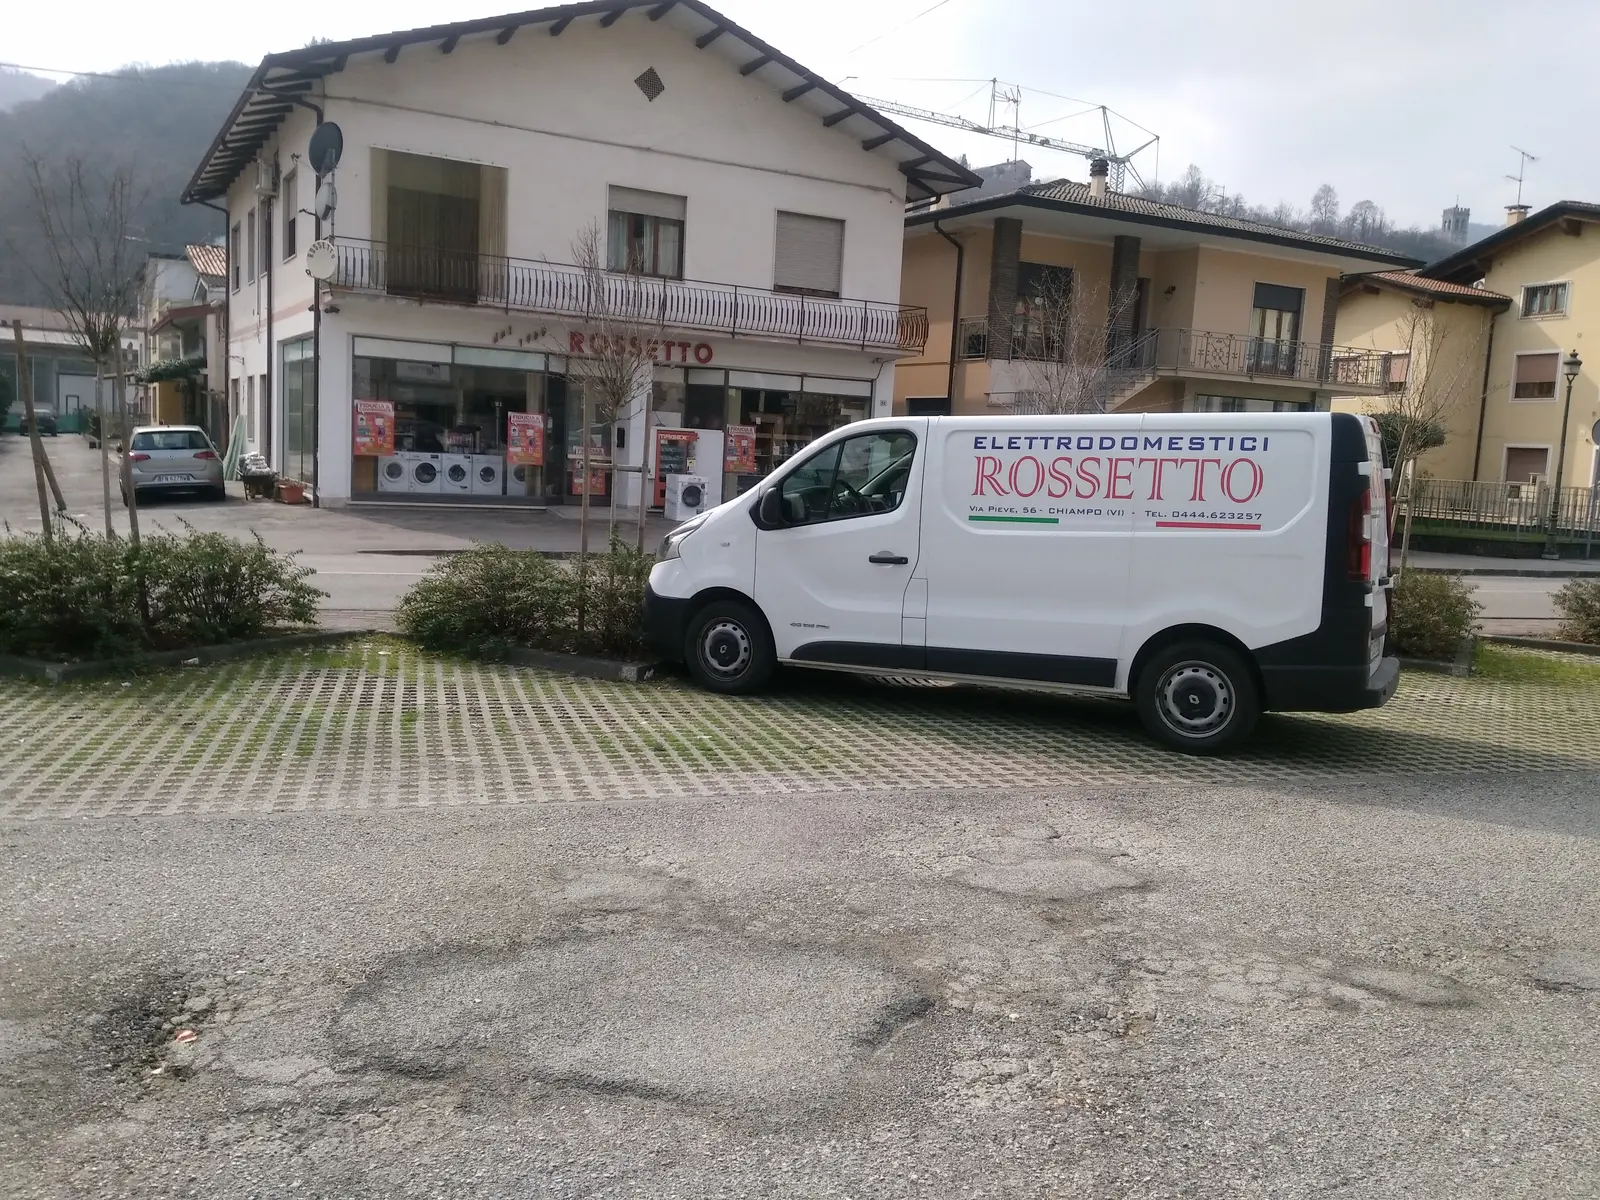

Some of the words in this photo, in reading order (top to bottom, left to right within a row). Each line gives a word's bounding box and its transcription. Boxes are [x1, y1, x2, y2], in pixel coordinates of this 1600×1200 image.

[569, 331, 714, 365] ROSSETTO
[973, 436, 1269, 452] ELETTRODOMESTICI
[970, 455, 1264, 503] ROSSETTO
[1048, 507, 1102, 516] CHIAMPO
[1106, 509, 1125, 517] (VI)
[1171, 510, 1263, 520] 0444.623257
